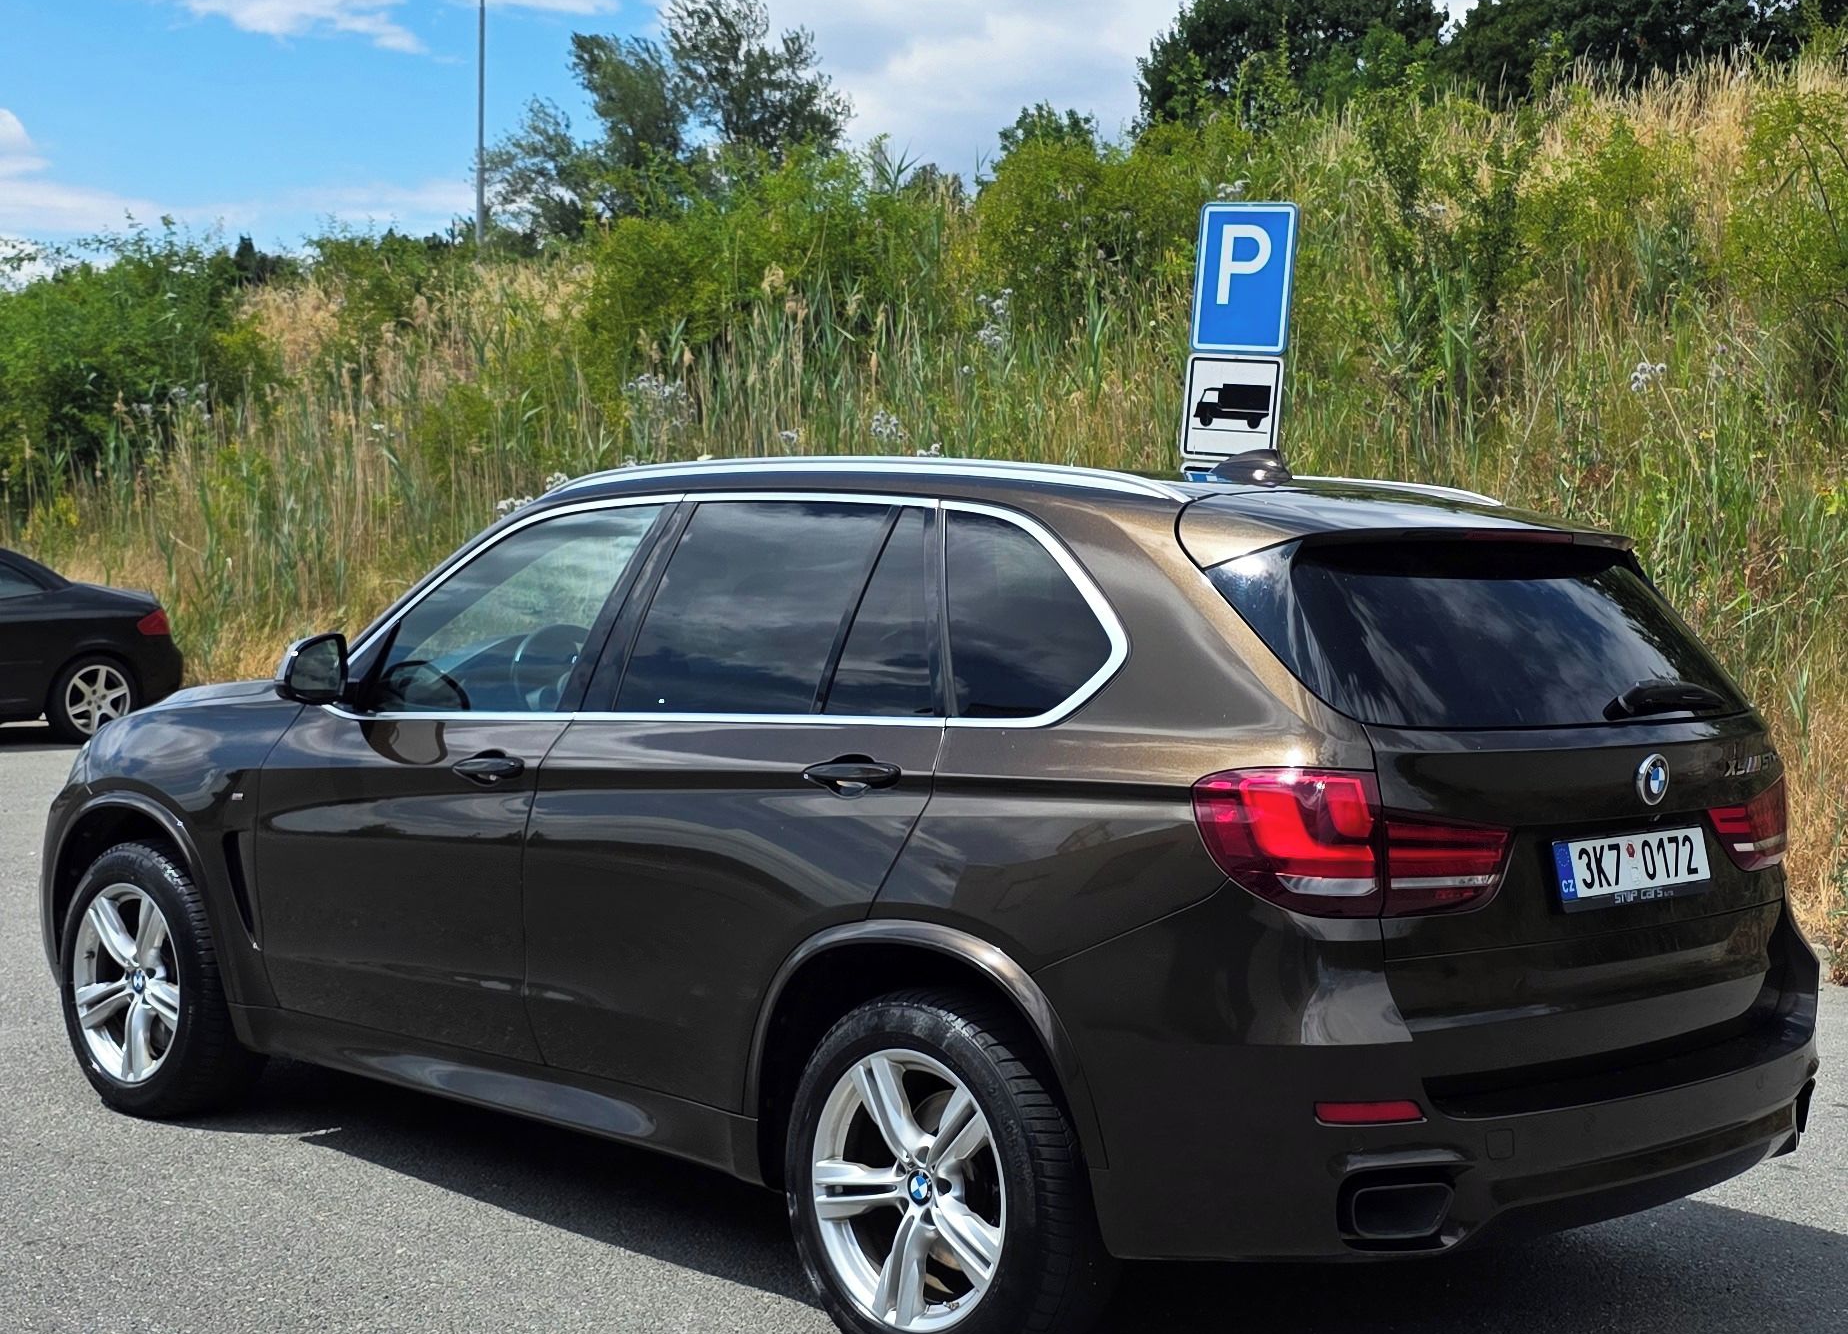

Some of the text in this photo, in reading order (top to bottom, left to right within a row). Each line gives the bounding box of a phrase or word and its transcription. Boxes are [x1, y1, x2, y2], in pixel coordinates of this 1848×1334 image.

[1216, 224, 1272, 305] P
[1561, 879, 1576, 893] CZ
[1578, 834, 1699, 889] 3K7 0172
